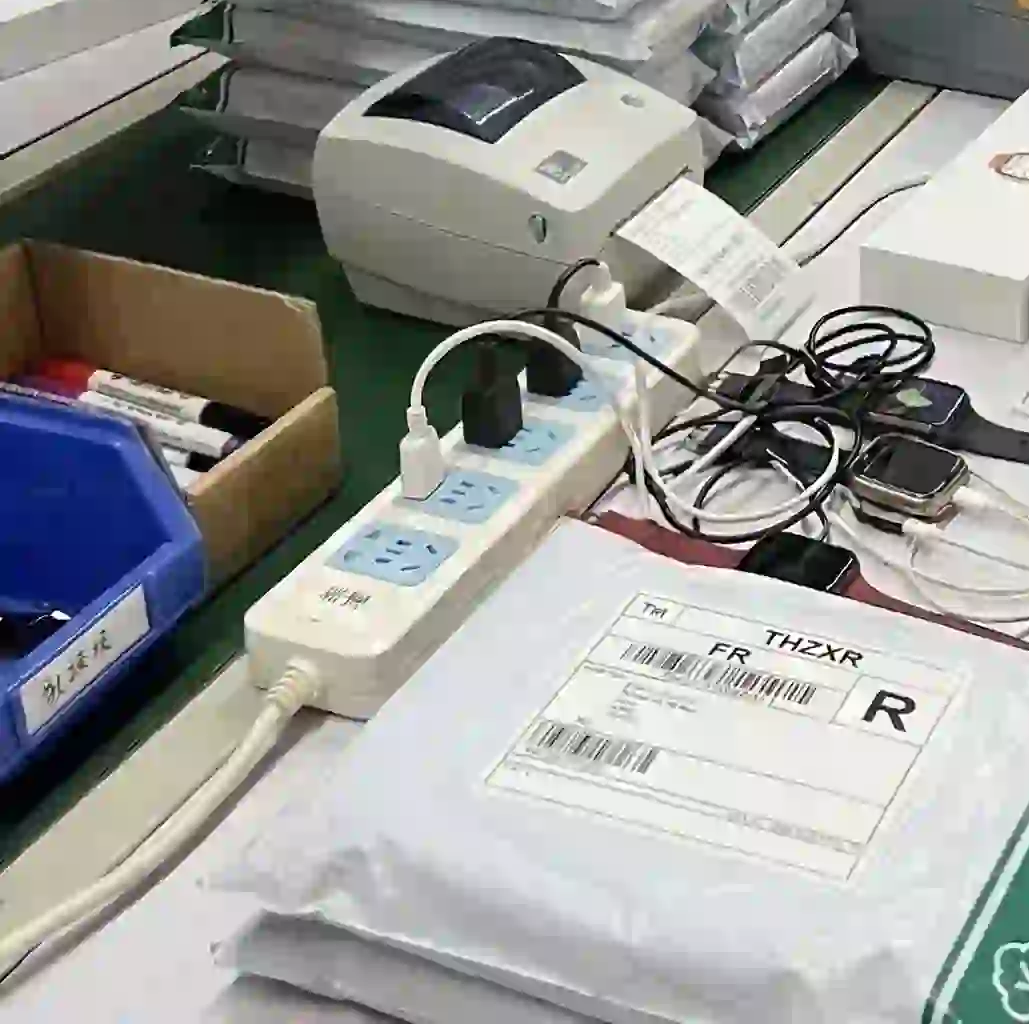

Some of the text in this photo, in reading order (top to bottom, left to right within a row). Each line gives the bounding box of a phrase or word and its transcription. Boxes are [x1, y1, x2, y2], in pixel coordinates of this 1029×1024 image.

[708, 642, 753, 665] FR
[765, 629, 864, 669] THZXR
[861, 689, 917, 734] R
